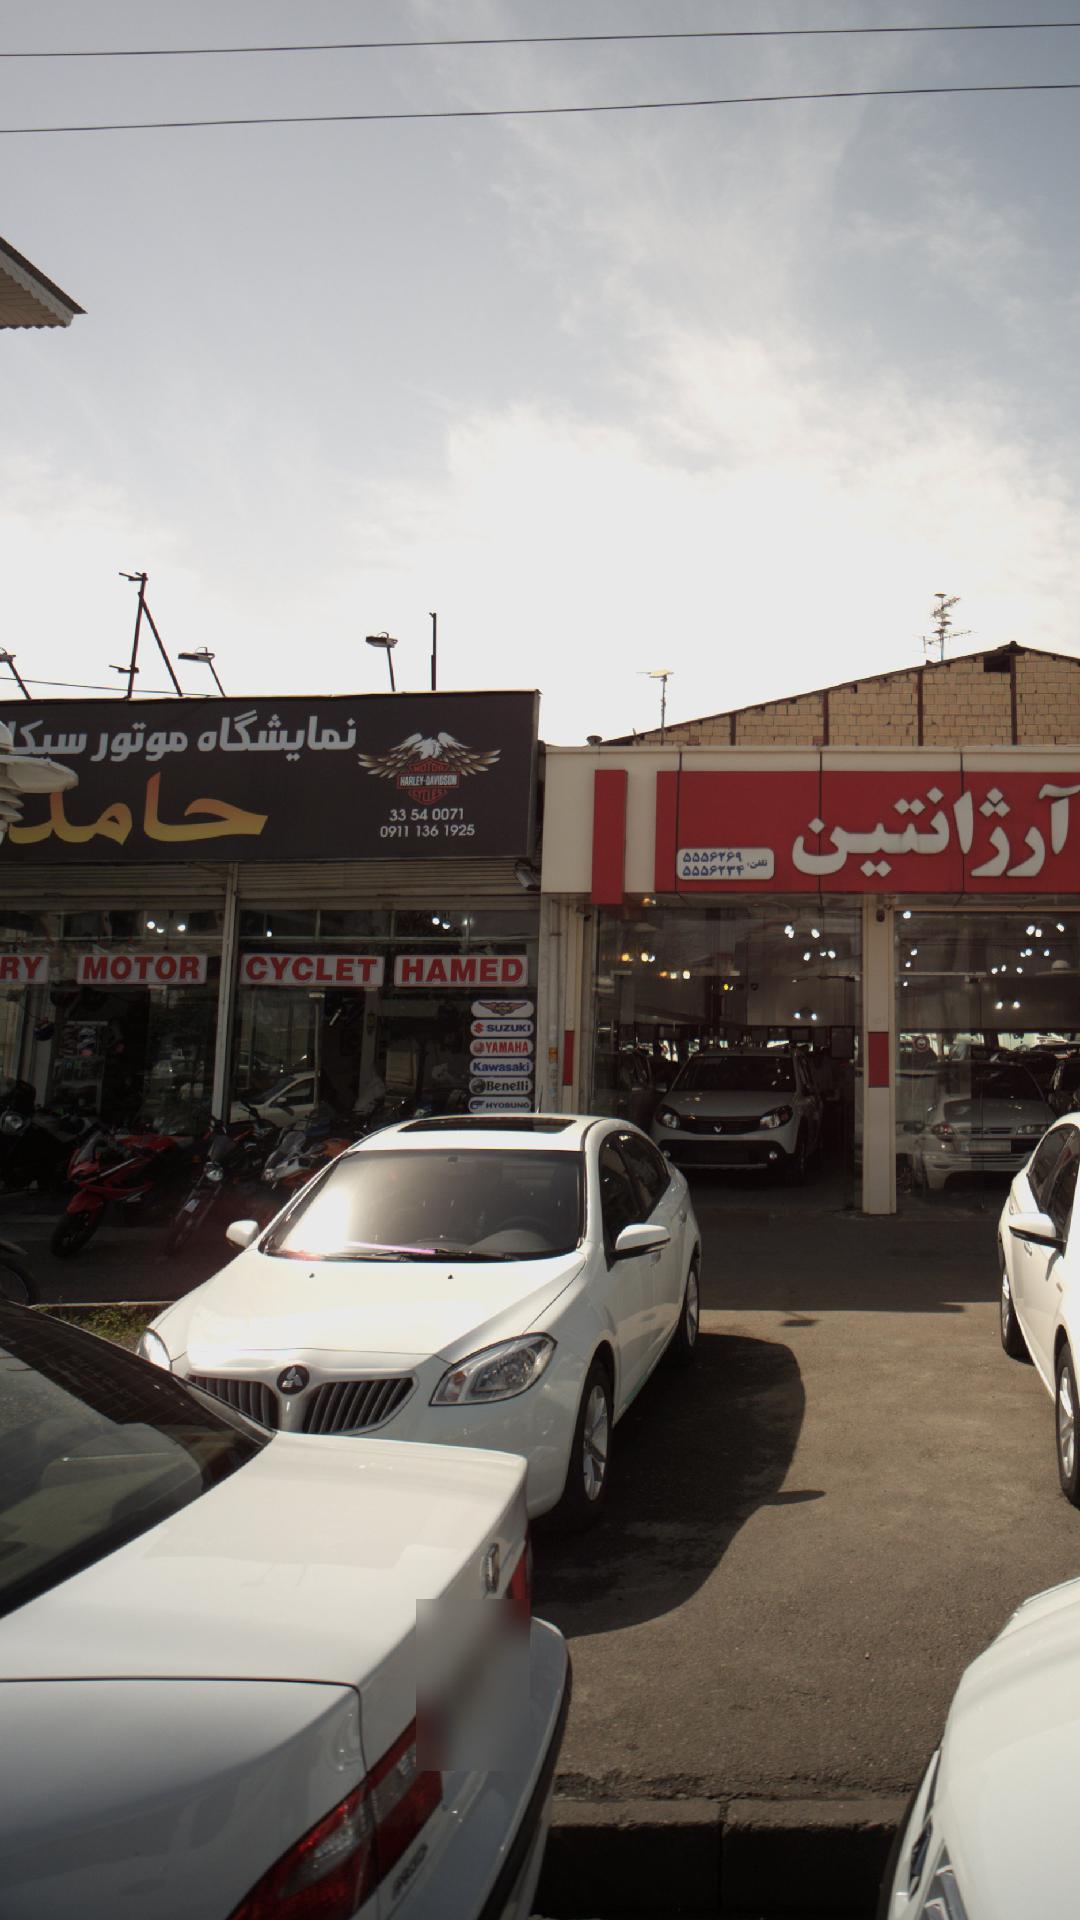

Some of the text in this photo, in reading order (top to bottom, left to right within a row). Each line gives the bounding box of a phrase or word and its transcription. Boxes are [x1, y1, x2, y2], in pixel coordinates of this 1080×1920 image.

[7, 709, 357, 763] نمایشگاه موتور سیکل
[8, 771, 269, 847] حامد
[389, 807, 464, 821] 33 54 0071
[379, 824, 475, 838] 0911 136 1925
[792, 783, 1080, 877] آرژانتین
[82, 956, 200, 980] MOTOR
[245, 956, 377, 981] CYCLET
[401, 958, 523, 982] HAMED
[486, 1024, 531, 1033] SUZUKI
[485, 1041, 529, 1053] YAMAHA
[473, 1062, 530, 1072] Kawasaki
[486, 1081, 529, 1092] Benelli
